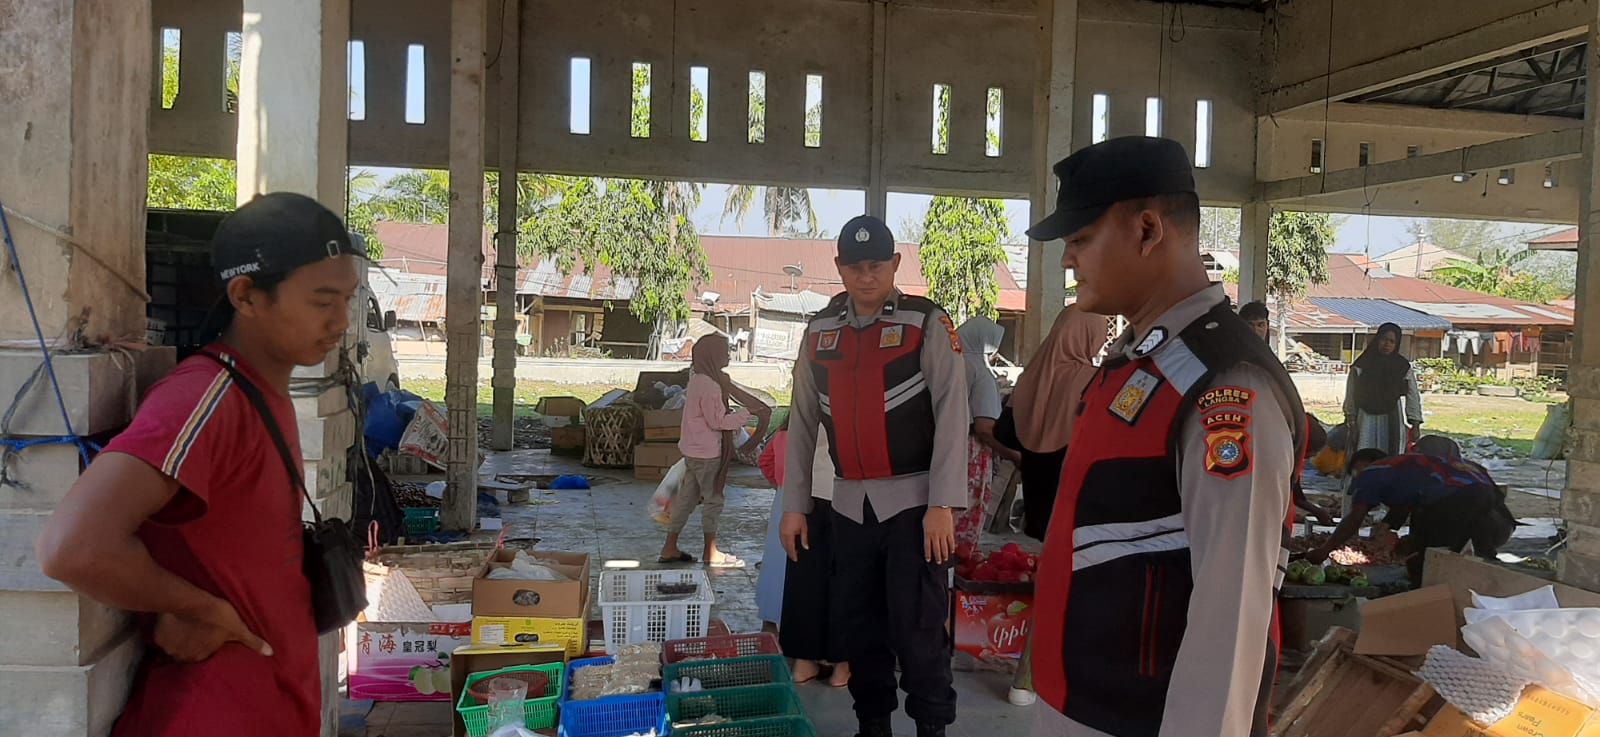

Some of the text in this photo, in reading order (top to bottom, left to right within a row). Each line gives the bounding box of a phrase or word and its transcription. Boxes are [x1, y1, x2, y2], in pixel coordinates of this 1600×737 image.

[1198, 389, 1249, 404] POLRES
[1204, 396, 1240, 407] LANGSA
[1207, 414, 1241, 425] ACEH
